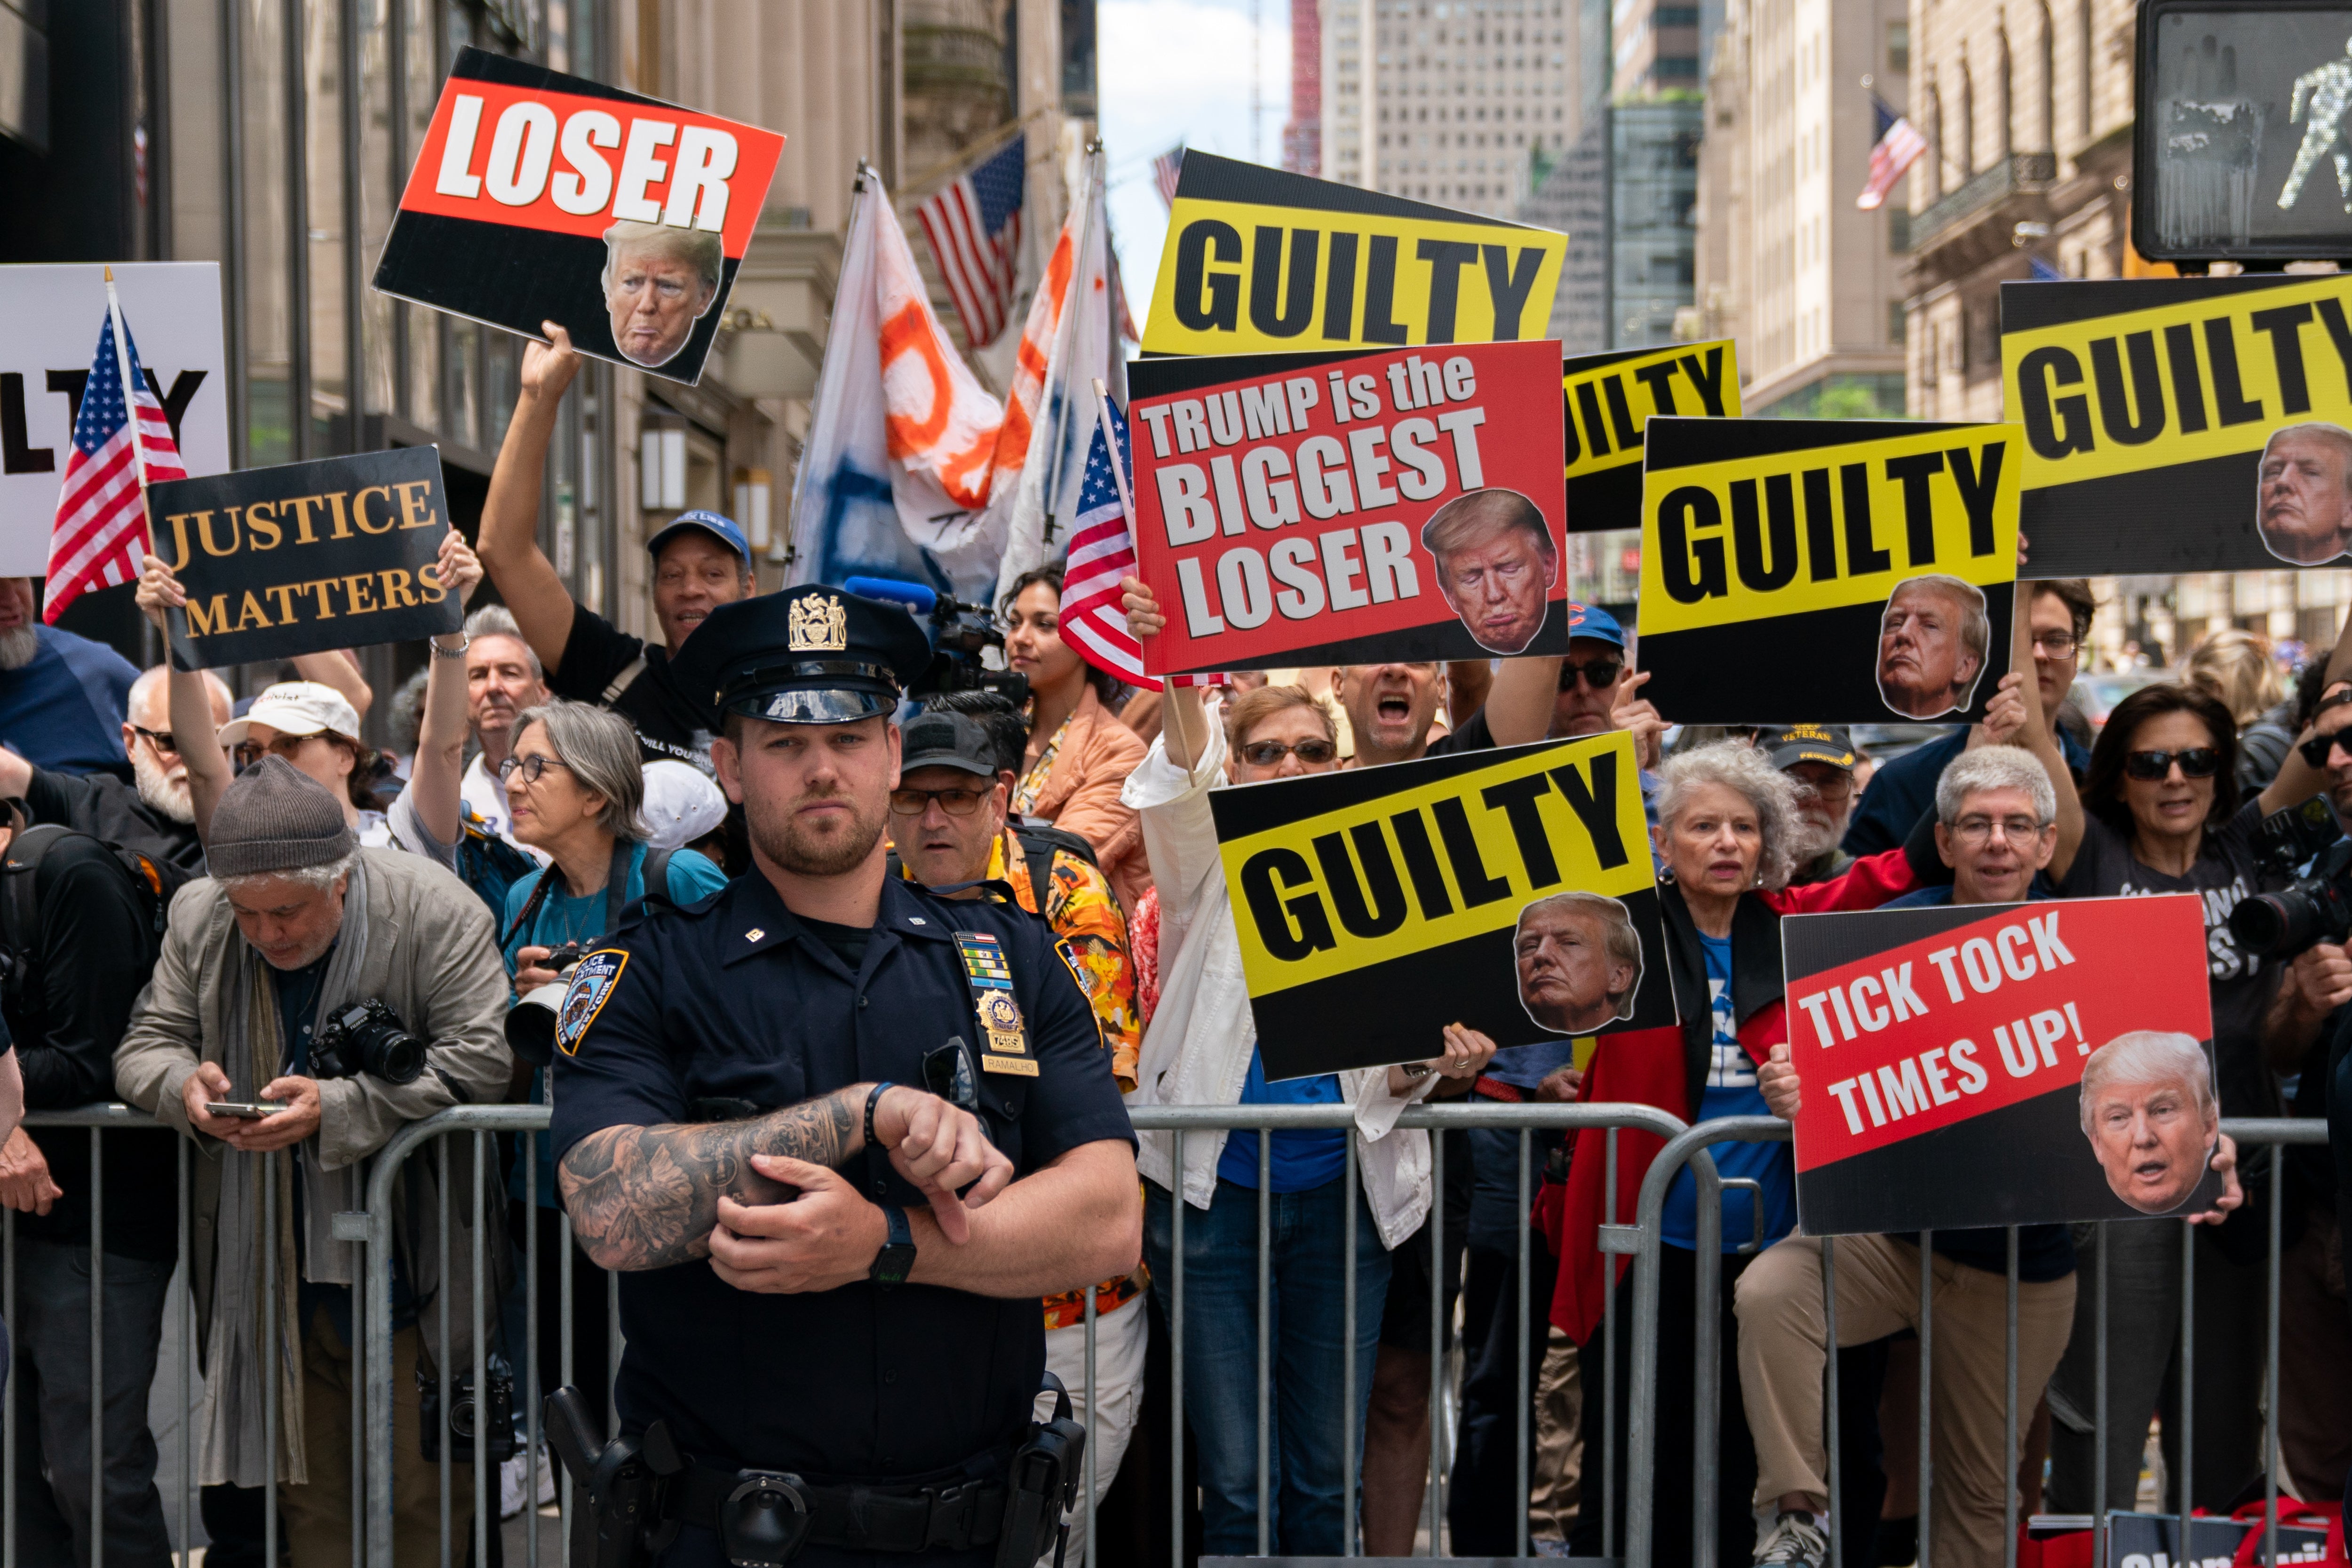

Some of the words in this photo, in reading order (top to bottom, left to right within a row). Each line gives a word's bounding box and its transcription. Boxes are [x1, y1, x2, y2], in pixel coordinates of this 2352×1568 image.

[436, 94, 739, 233] LOSER
[1173, 219, 1547, 346] GUILTY
[1140, 376, 1319, 459] TRUMP
[1328, 370, 1381, 423] is
[1387, 355, 1477, 411] the
[166, 480, 437, 573] JUSTICE
[1155, 407, 1486, 547] BIGGEST
[1657, 440, 2006, 605] GUILTY
[185, 565, 448, 638] MATTERS
[1176, 521, 1420, 639] LOSER
[668, 744, 692, 759] YOU
[1782, 730, 1832, 742] VETERAN
[1240, 750, 1629, 963] GUILTY
[589, 980, 613, 1011] YORK
[1798, 961, 1930, 1049] TICK
[1928, 910, 2075, 1004] TOCK
[988, 1059, 1034, 1073] RAMALHO
[994, 1035, 1018, 1047] 7485
[1828, 1038, 1989, 1136] TIMES
[1993, 1002, 2090, 1078] UP!
